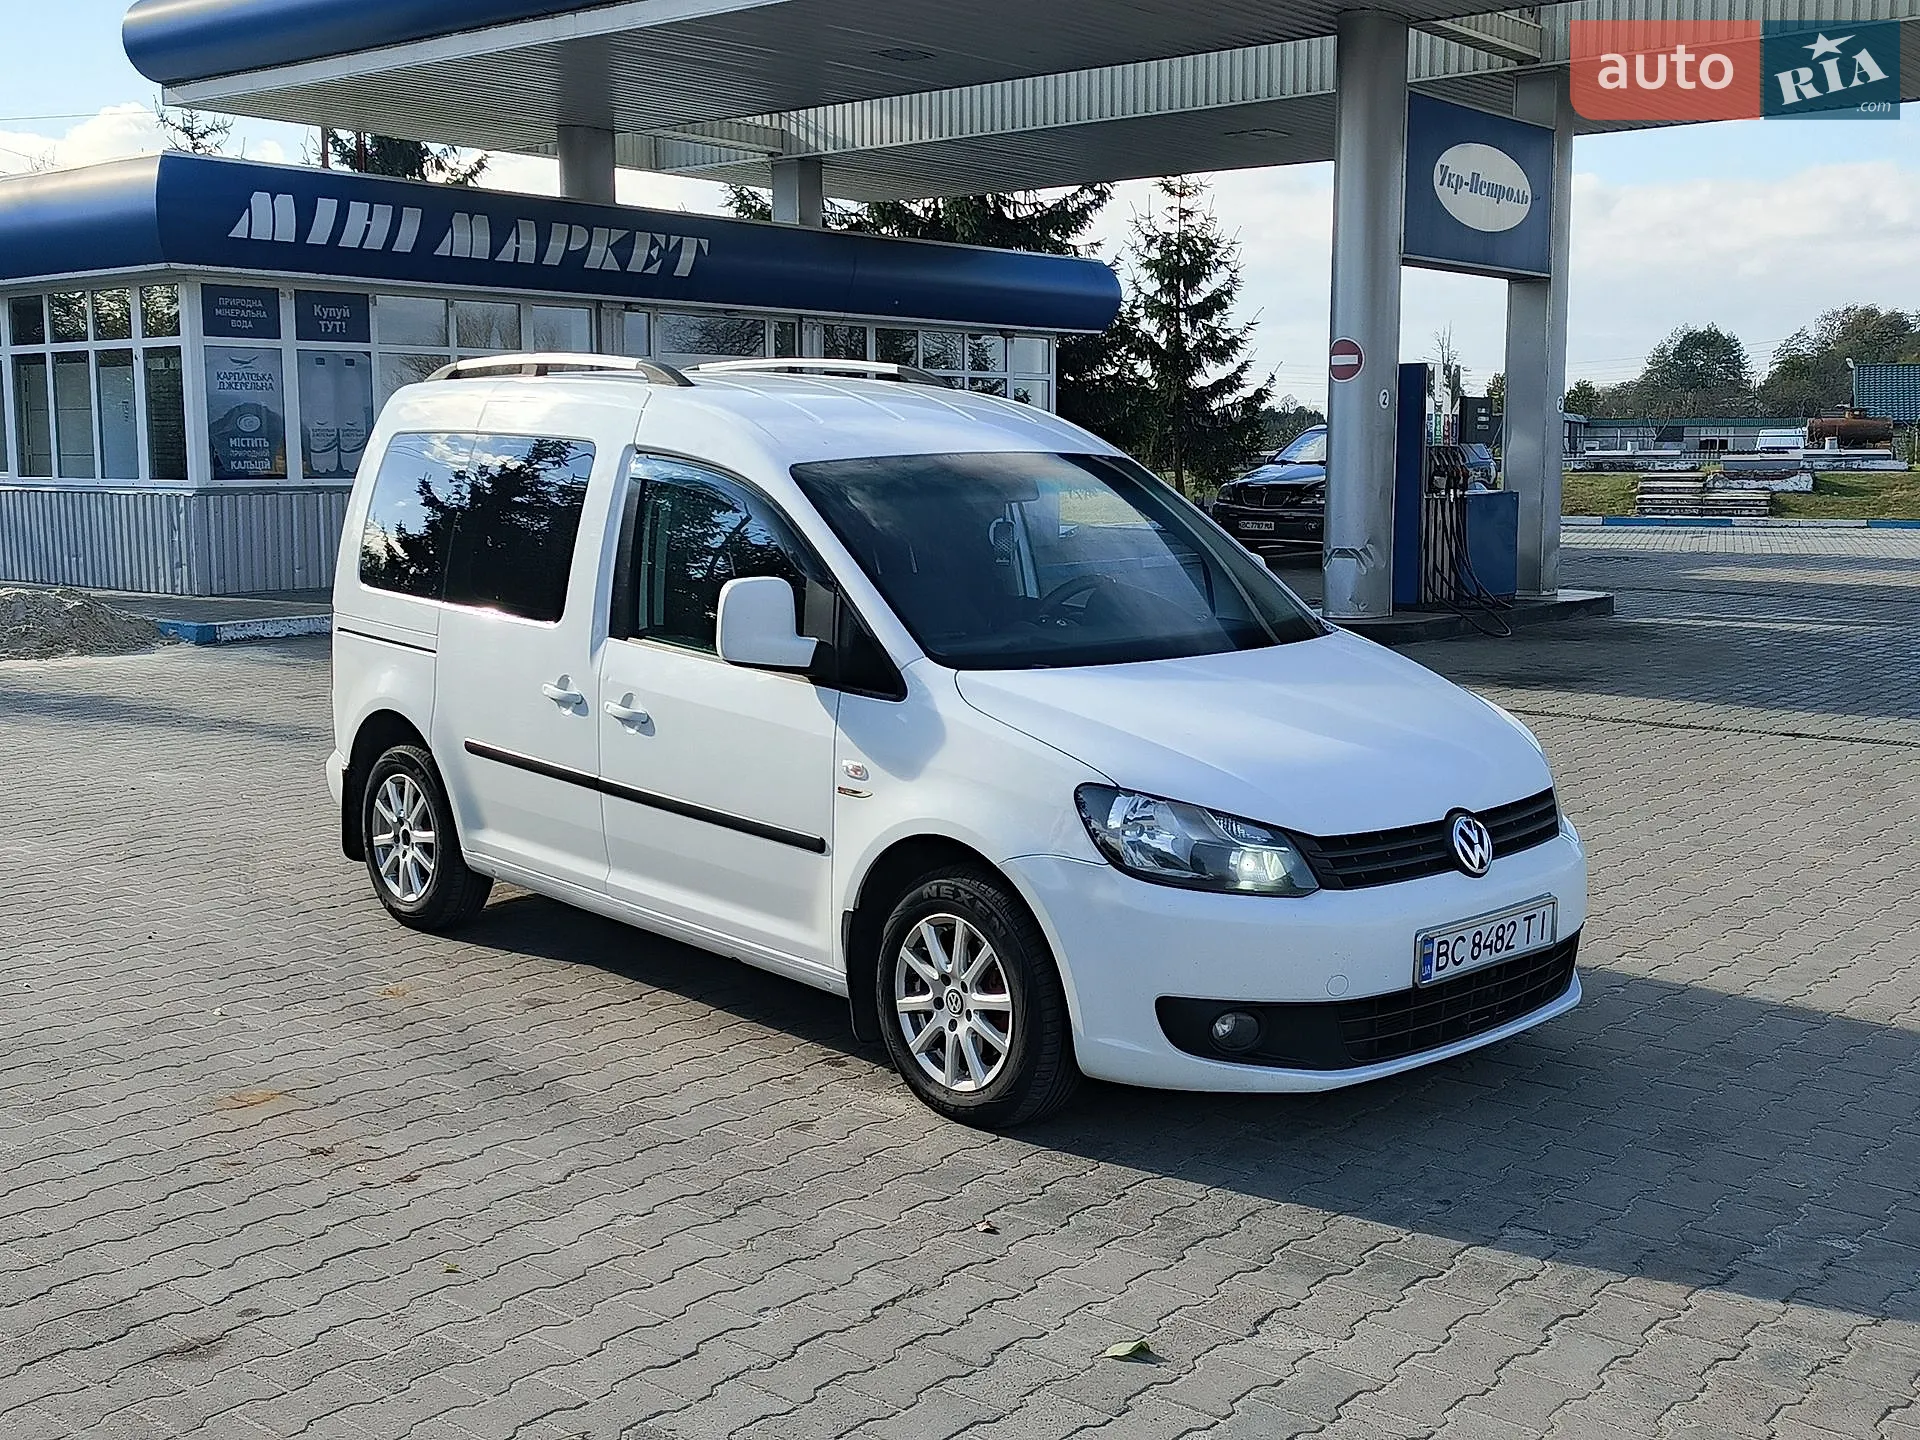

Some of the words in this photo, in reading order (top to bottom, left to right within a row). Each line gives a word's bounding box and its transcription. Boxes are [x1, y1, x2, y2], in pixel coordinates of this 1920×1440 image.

[228, 191, 422, 252] МІНІ
[433, 212, 709, 276] МАРКЕТ
[218, 297, 263, 308] ПРИРОДНА
[215, 308, 267, 319] МІНЕРАЛЬНА
[313, 304, 350, 320] Купуй
[231, 319, 253, 329] ВОДА
[319, 320, 346, 333] ТУТ!
[216, 371, 274, 383] КАРПАТСЬКА
[217, 381, 275, 392] ДЖЕРЕЛЬНА
[229, 437, 270, 448] МІСТИТЬ
[1435, 935, 1467, 973] BC
[1470, 920, 1518, 961] 8482
